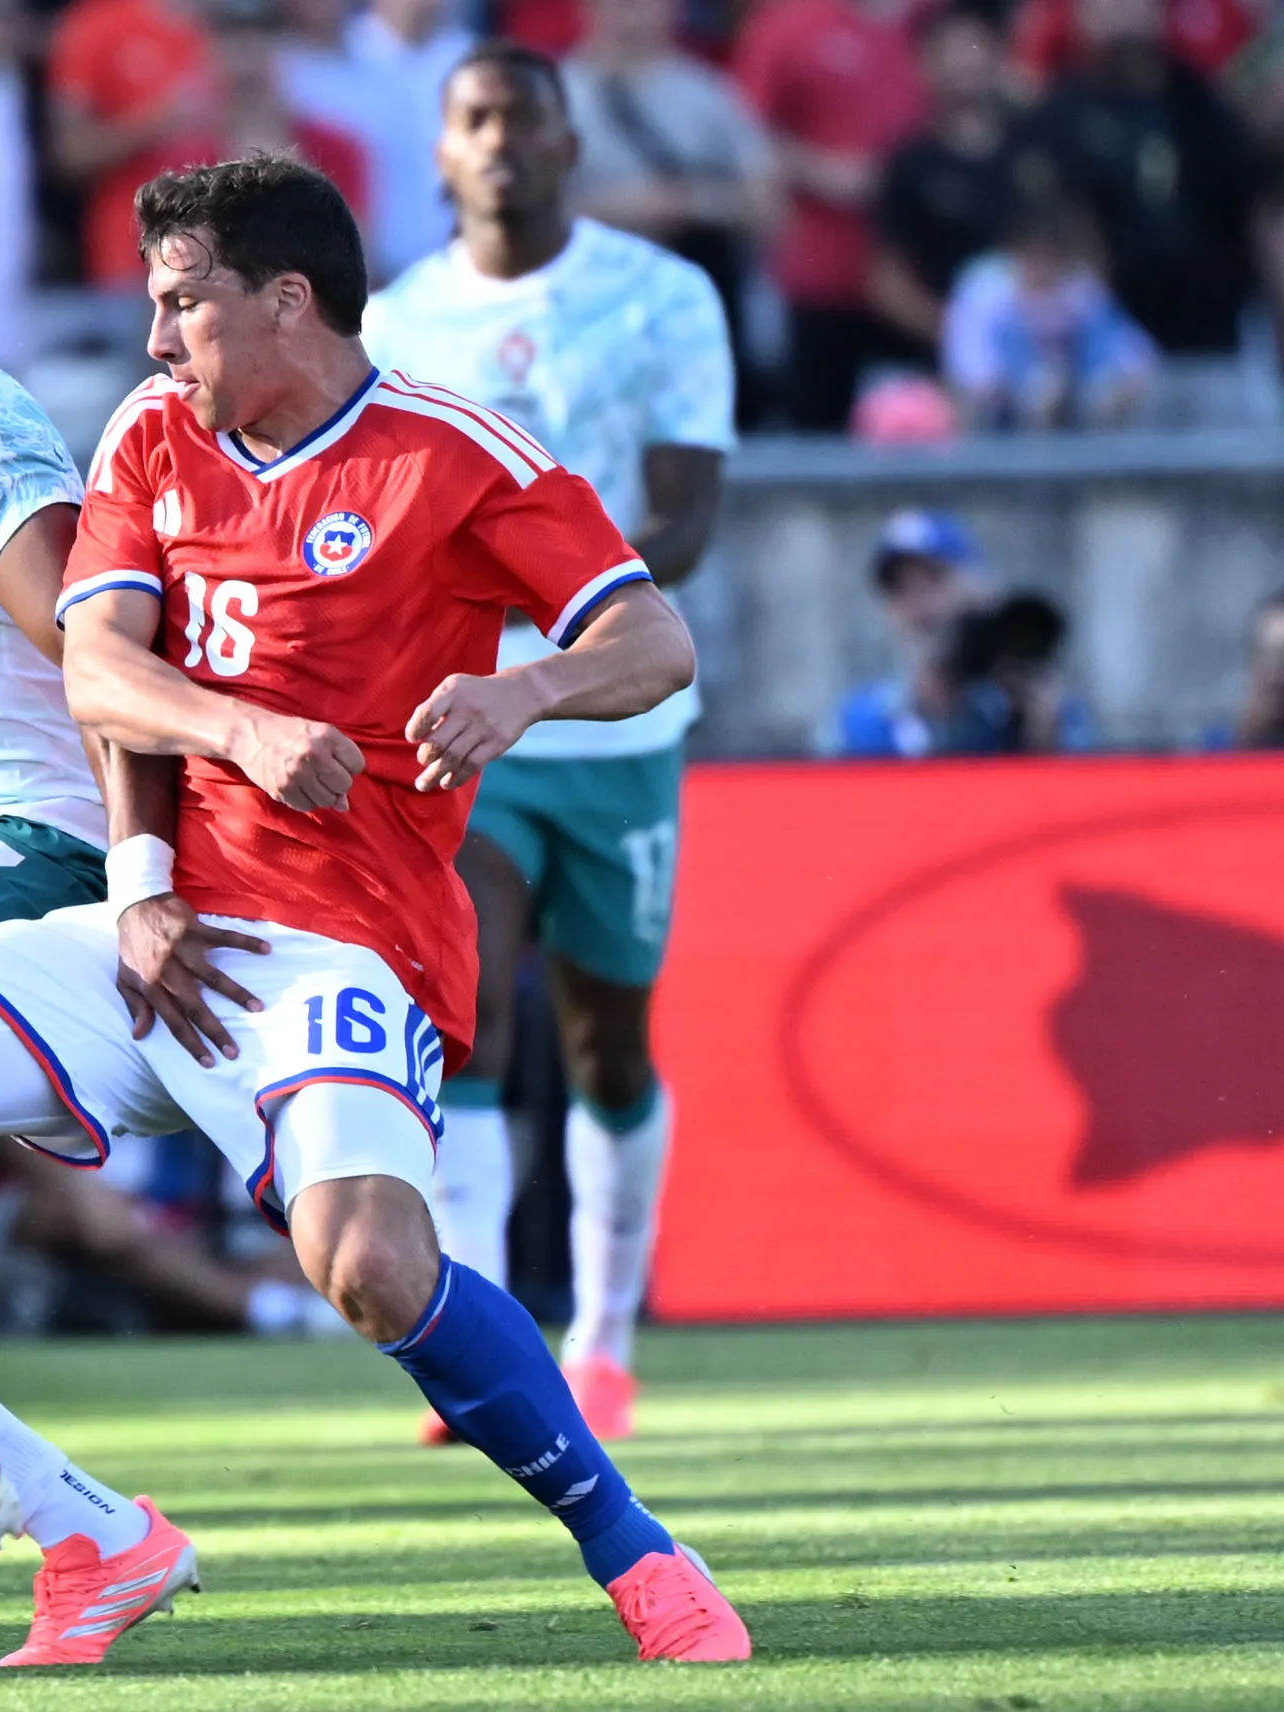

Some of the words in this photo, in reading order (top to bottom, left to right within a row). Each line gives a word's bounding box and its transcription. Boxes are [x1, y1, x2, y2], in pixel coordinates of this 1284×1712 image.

[184, 571, 259, 677] 16
[304, 987, 387, 1055] 16
[505, 1433, 570, 1477] CHILE
